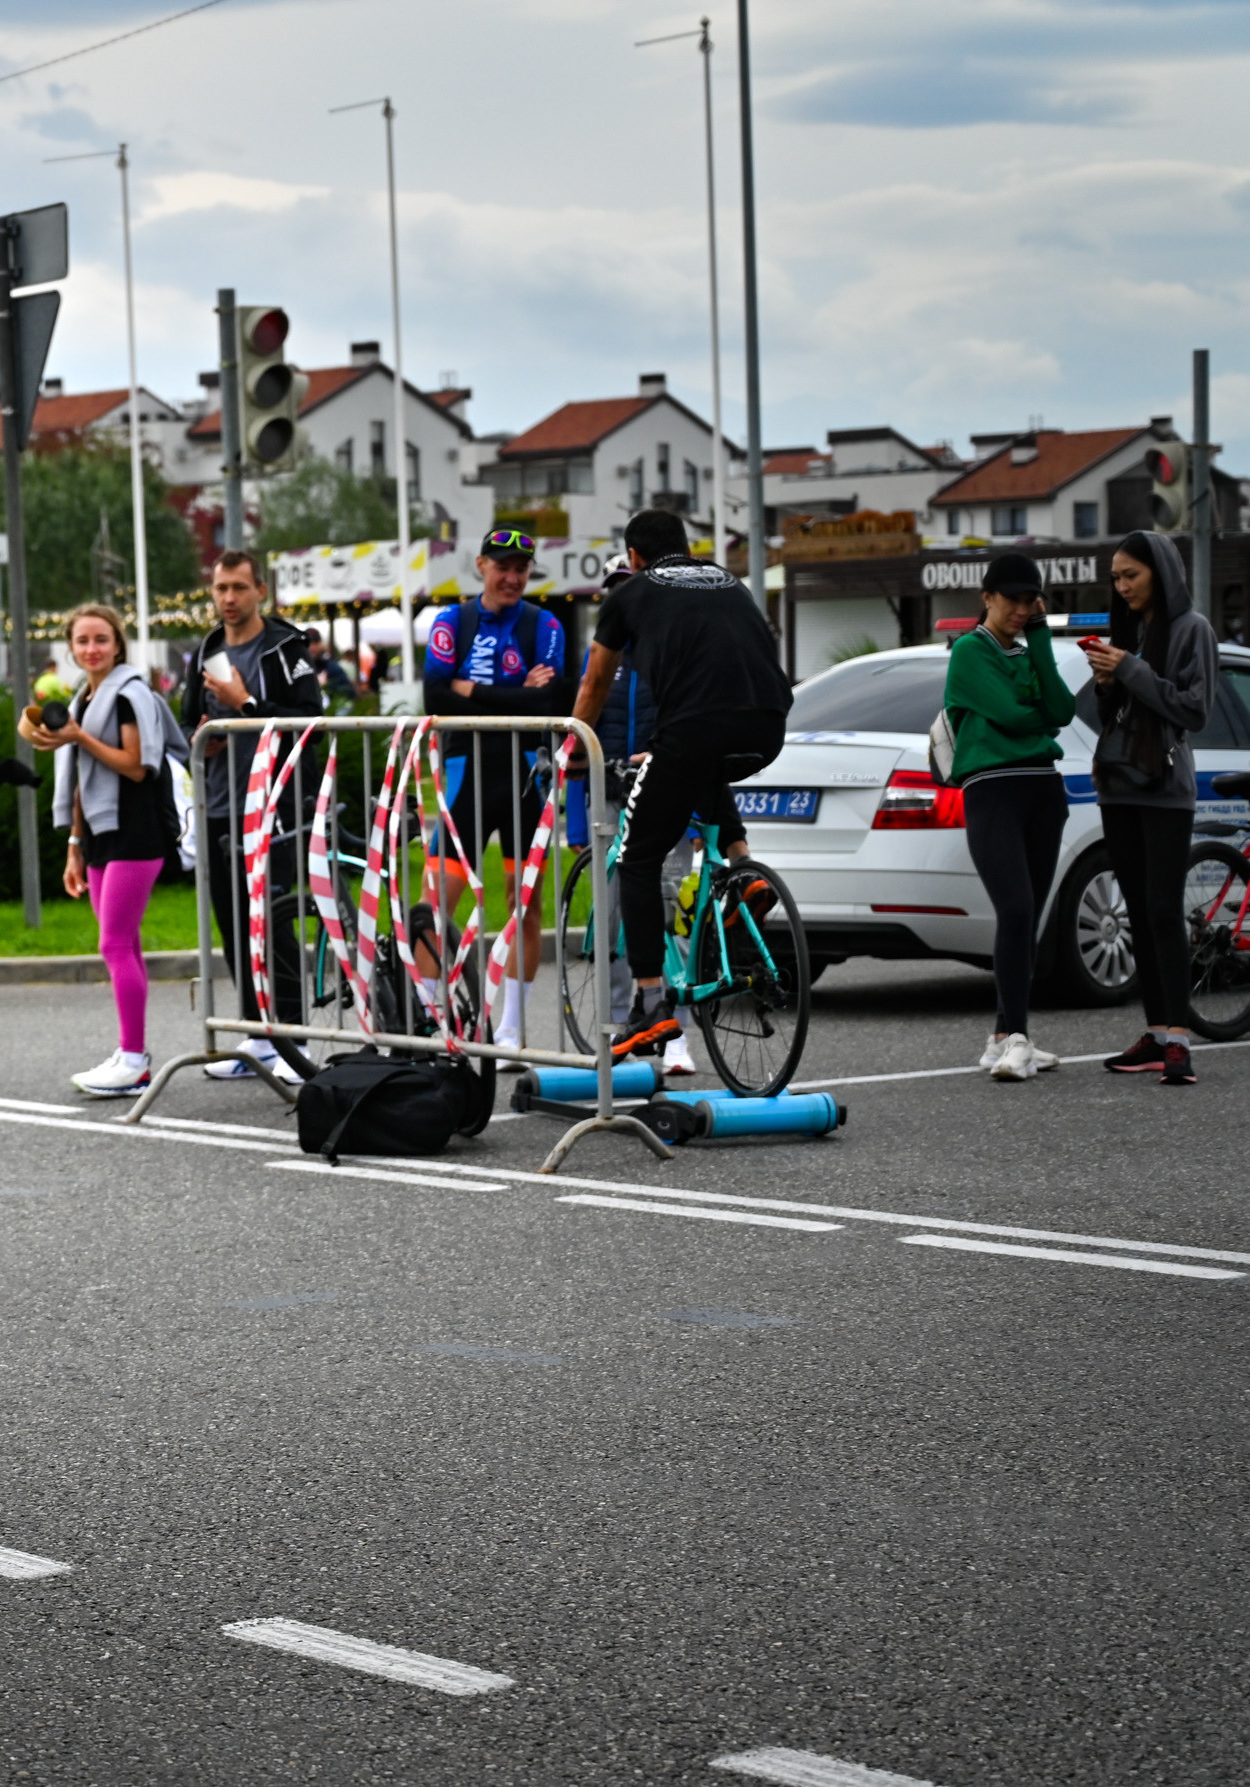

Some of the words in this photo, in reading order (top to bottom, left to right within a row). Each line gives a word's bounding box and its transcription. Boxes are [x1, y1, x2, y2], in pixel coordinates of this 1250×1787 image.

[563, 551, 619, 579] ГО
[1037, 556, 1097, 590] УКТЫ
[789, 791, 811, 809] 23
